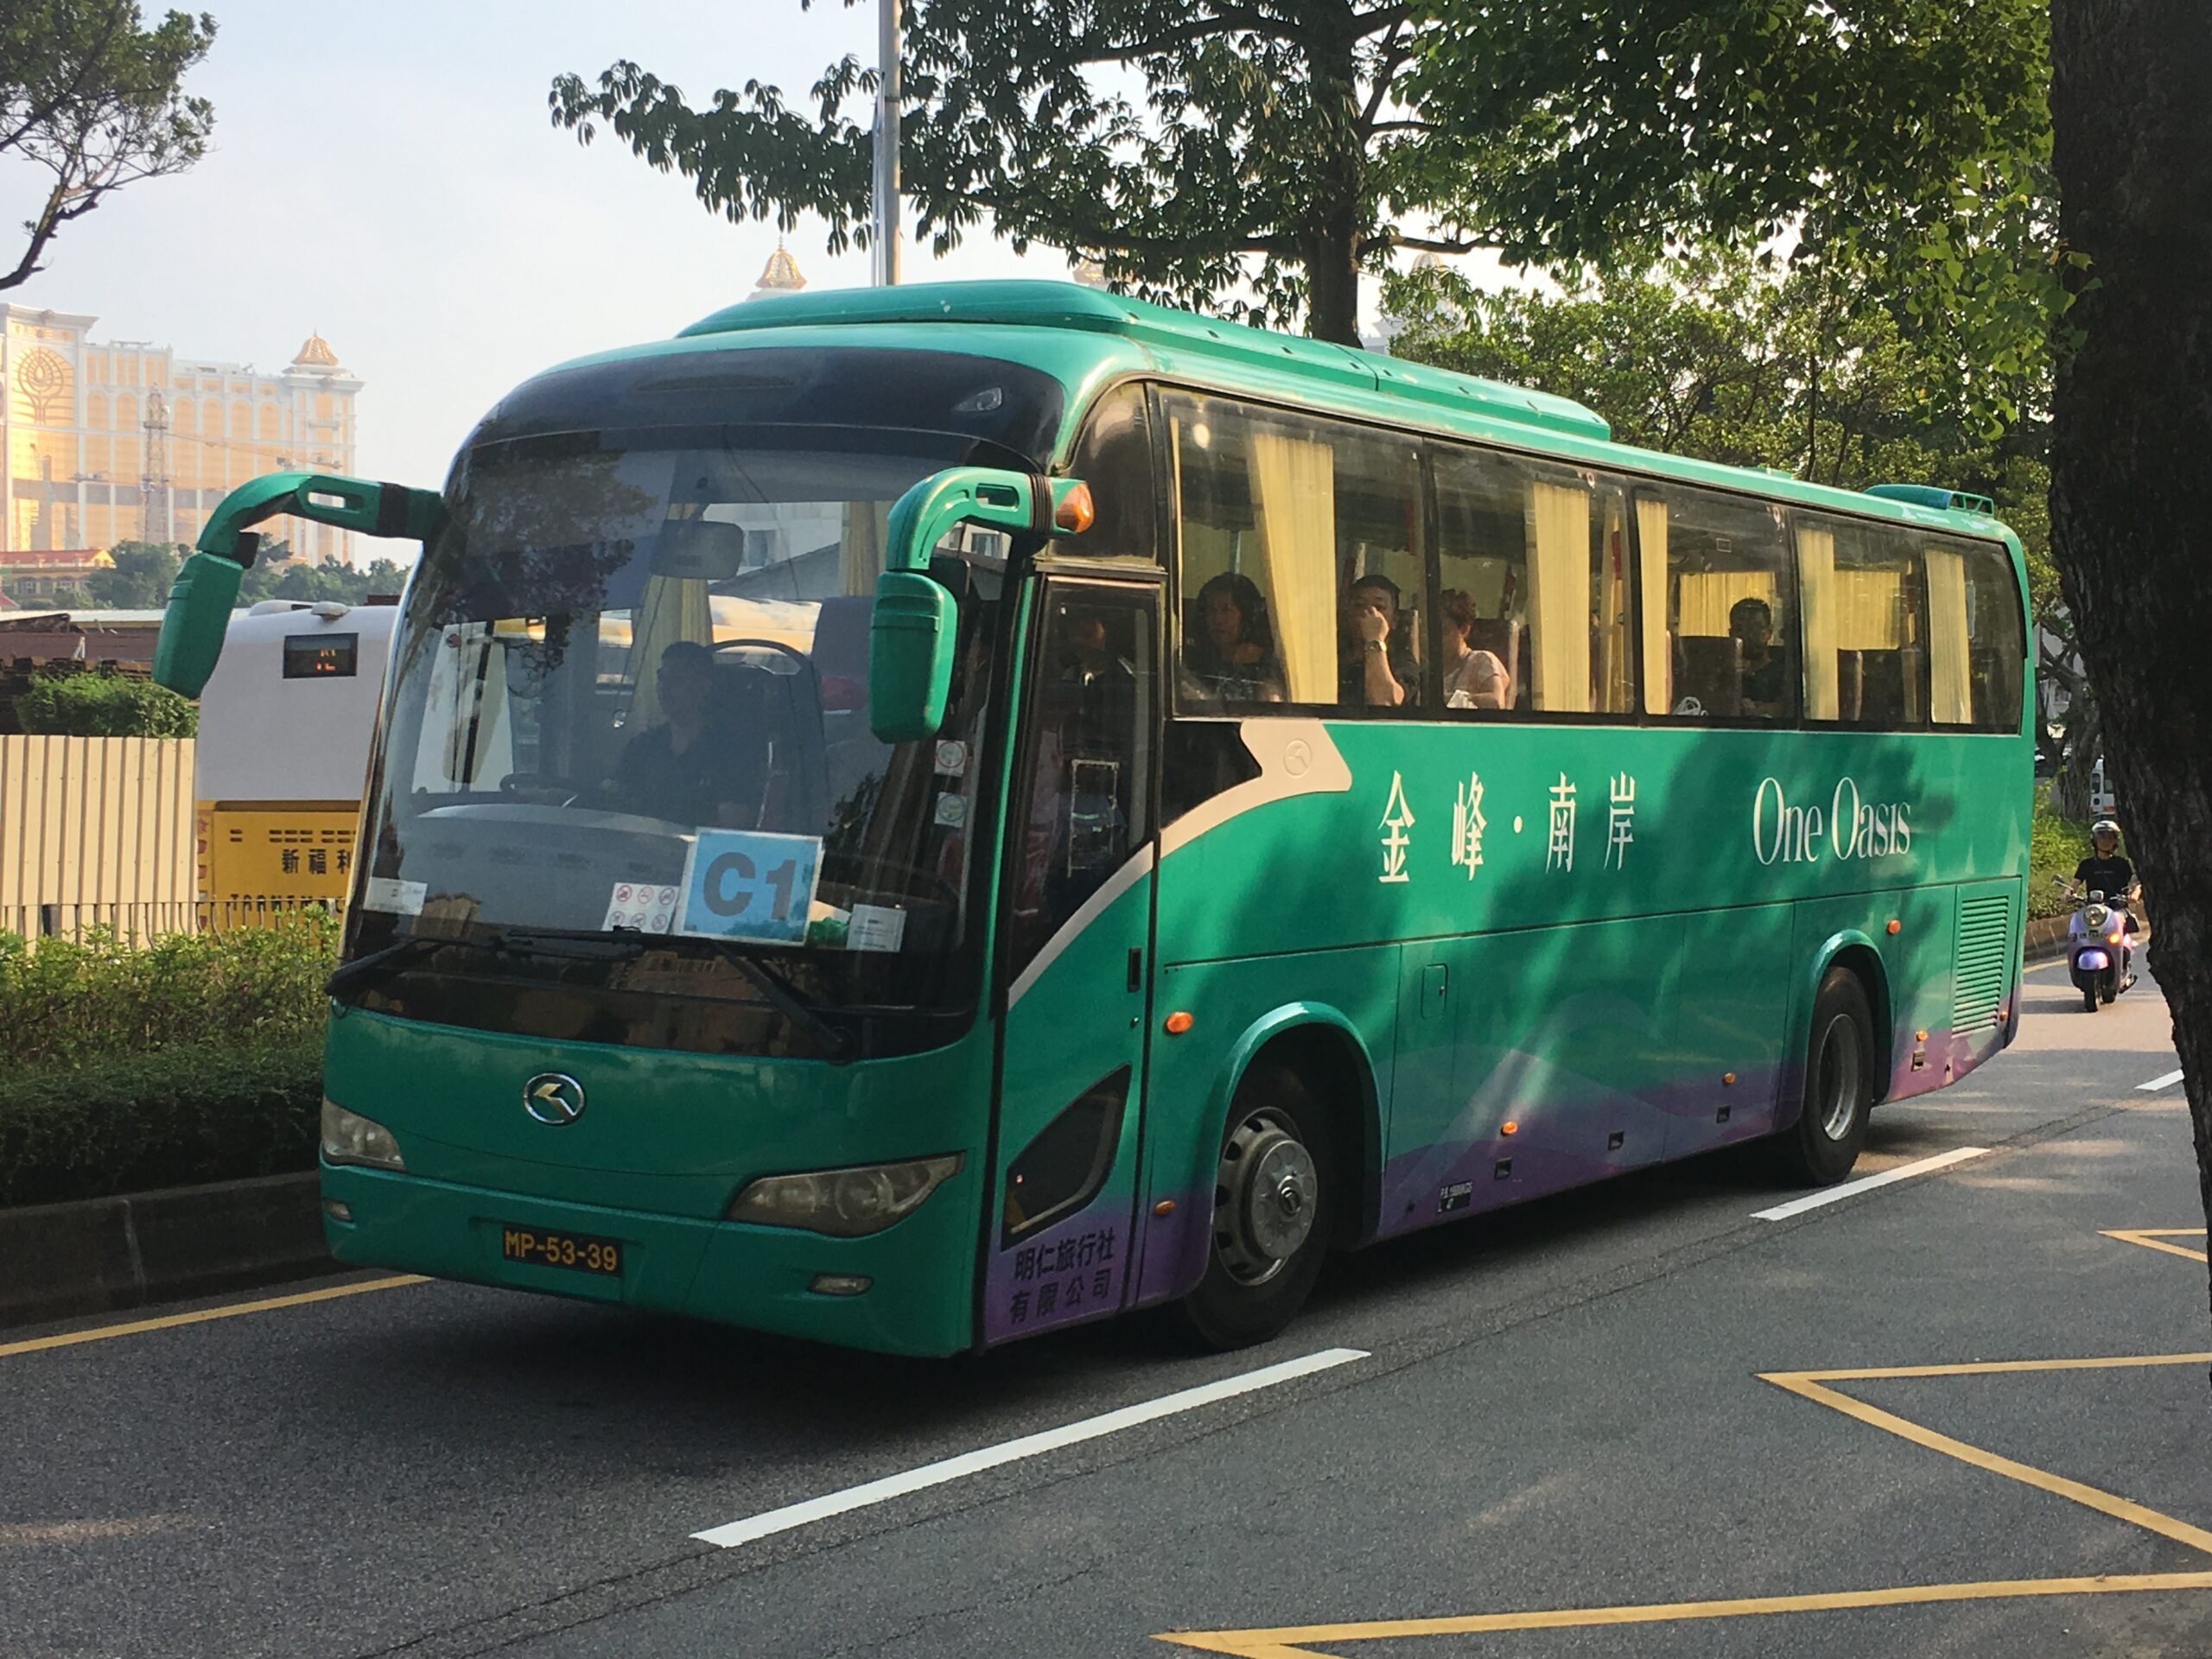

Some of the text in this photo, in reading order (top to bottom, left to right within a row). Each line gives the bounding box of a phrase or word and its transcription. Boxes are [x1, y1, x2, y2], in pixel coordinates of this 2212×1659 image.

[1753, 777, 1911, 865] One Oasis
[703, 851, 797, 920] C1
[505, 1230, 618, 1271] MP-53-39
[1014, 1227, 1115, 1281] 明仁旅行社
[1011, 1268, 1112, 1325] 有限公司
